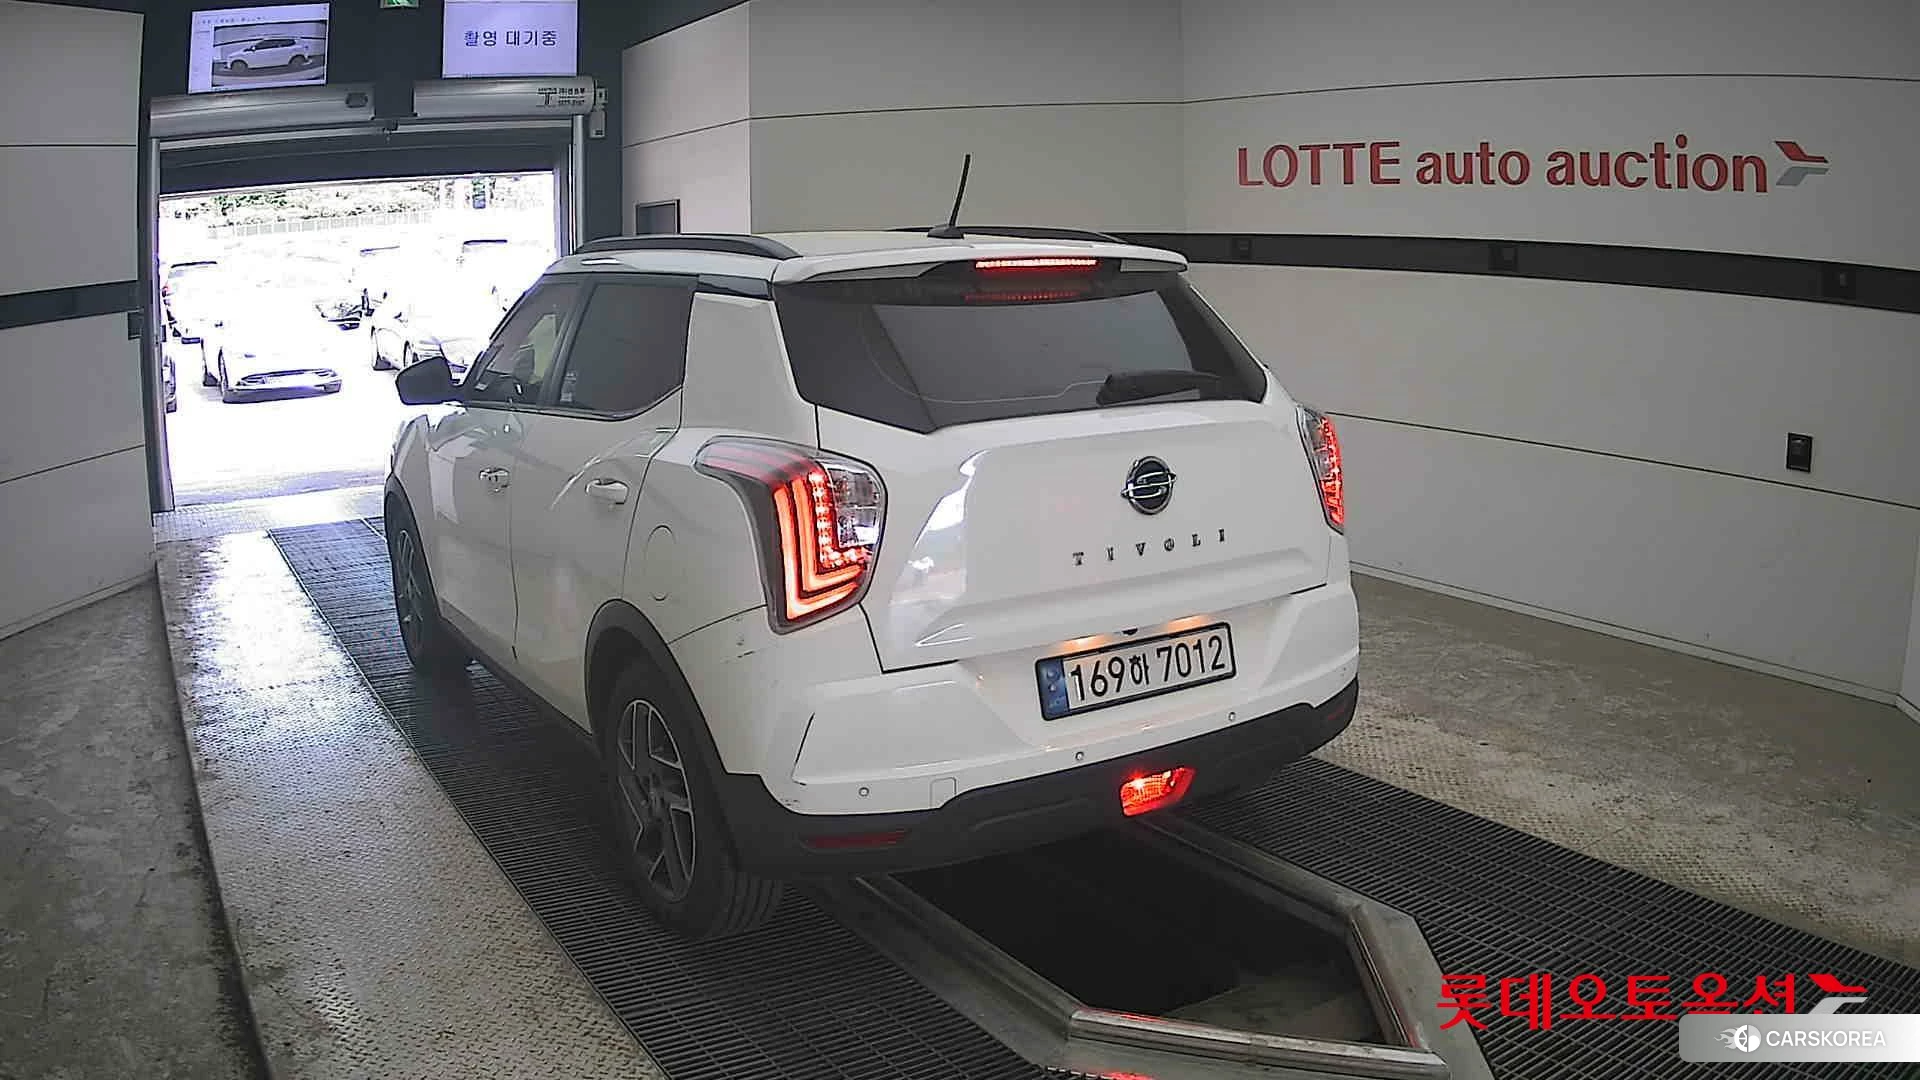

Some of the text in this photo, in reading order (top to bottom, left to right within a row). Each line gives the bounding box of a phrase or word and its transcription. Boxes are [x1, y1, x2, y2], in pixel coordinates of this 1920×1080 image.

[464, 30, 557, 47] 촬영 대기중
[1238, 134, 1768, 193] LOTTE auto auction
[1072, 528, 1225, 566] TIVOLI
[1068, 635, 1226, 701] 169하 7012
